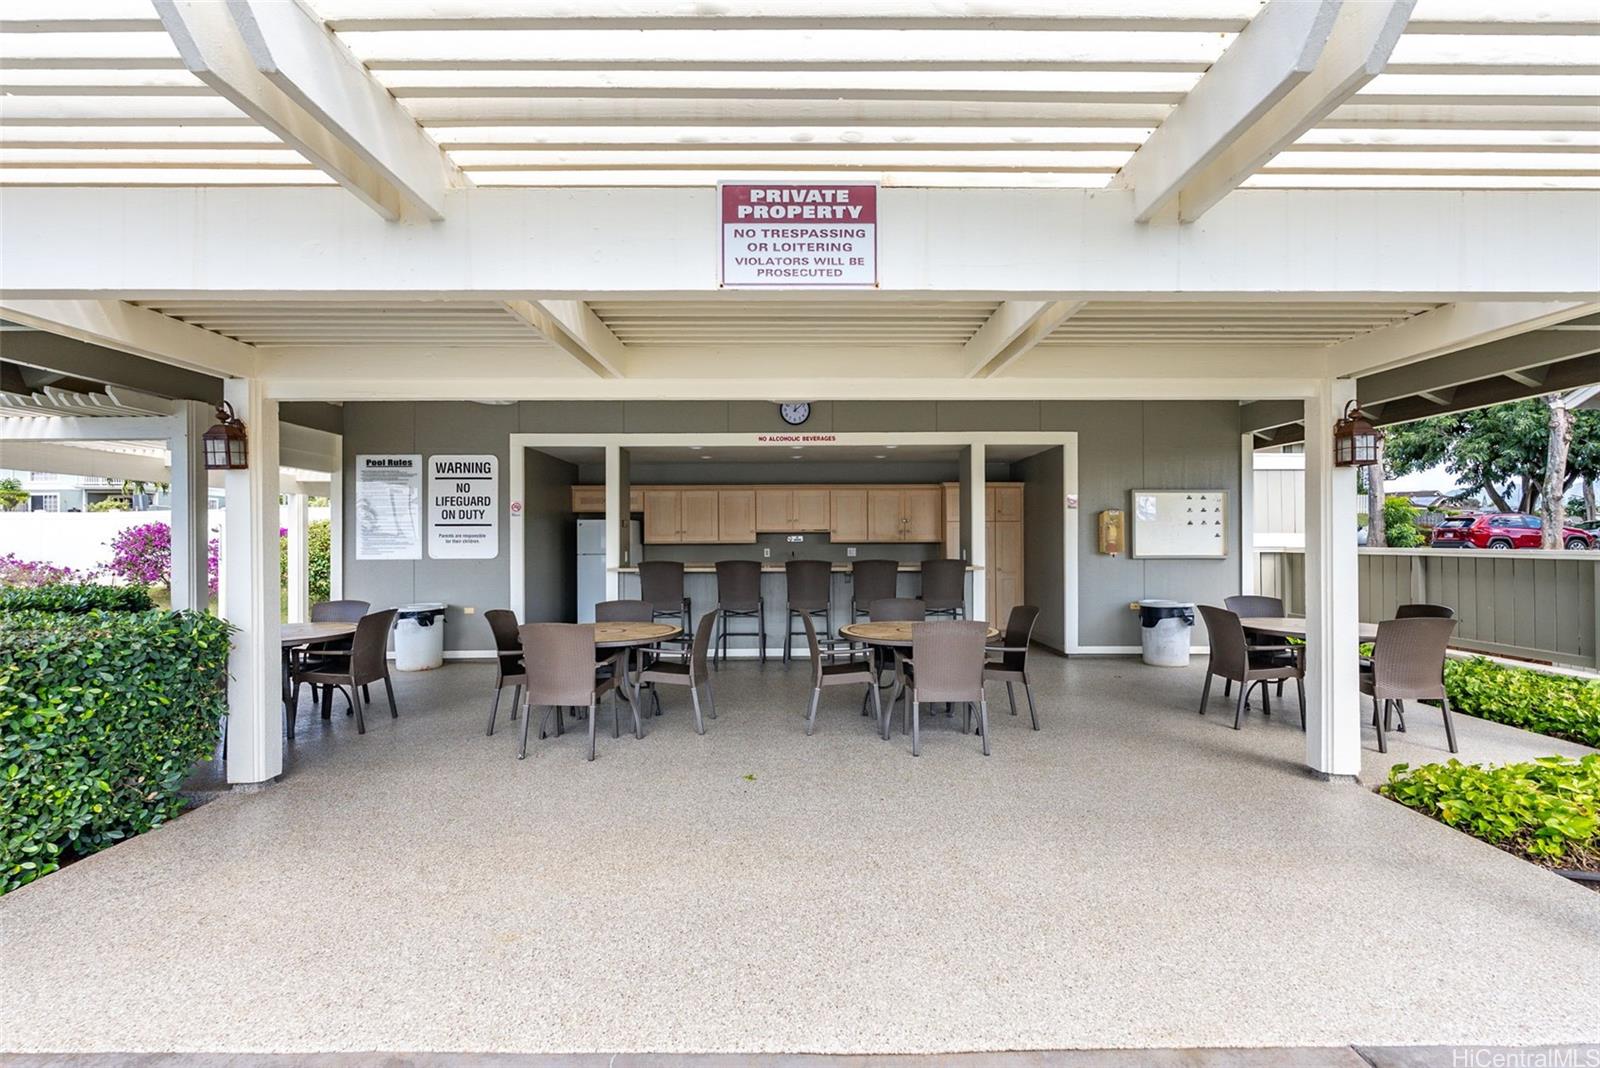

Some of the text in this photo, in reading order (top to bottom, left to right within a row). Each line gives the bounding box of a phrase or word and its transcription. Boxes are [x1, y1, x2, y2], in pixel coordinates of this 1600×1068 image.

[750, 189, 850, 203] PRIVATE
[737, 205, 863, 219] PROPERTY
[733, 228, 866, 239] NO TRESPASSING
[747, 242, 853, 252] OR LOITERING
[735, 257, 865, 266] VIOLATORS WILL BE
[757, 268, 843, 277] PROSECUTED
[366, 459, 413, 467] Pool Rules
[435, 461, 492, 474] WARNING
[456, 482, 471, 494] NO
[435, 496, 491, 507] LIFEGUARD
[441, 509, 486, 520] ON DUTY
